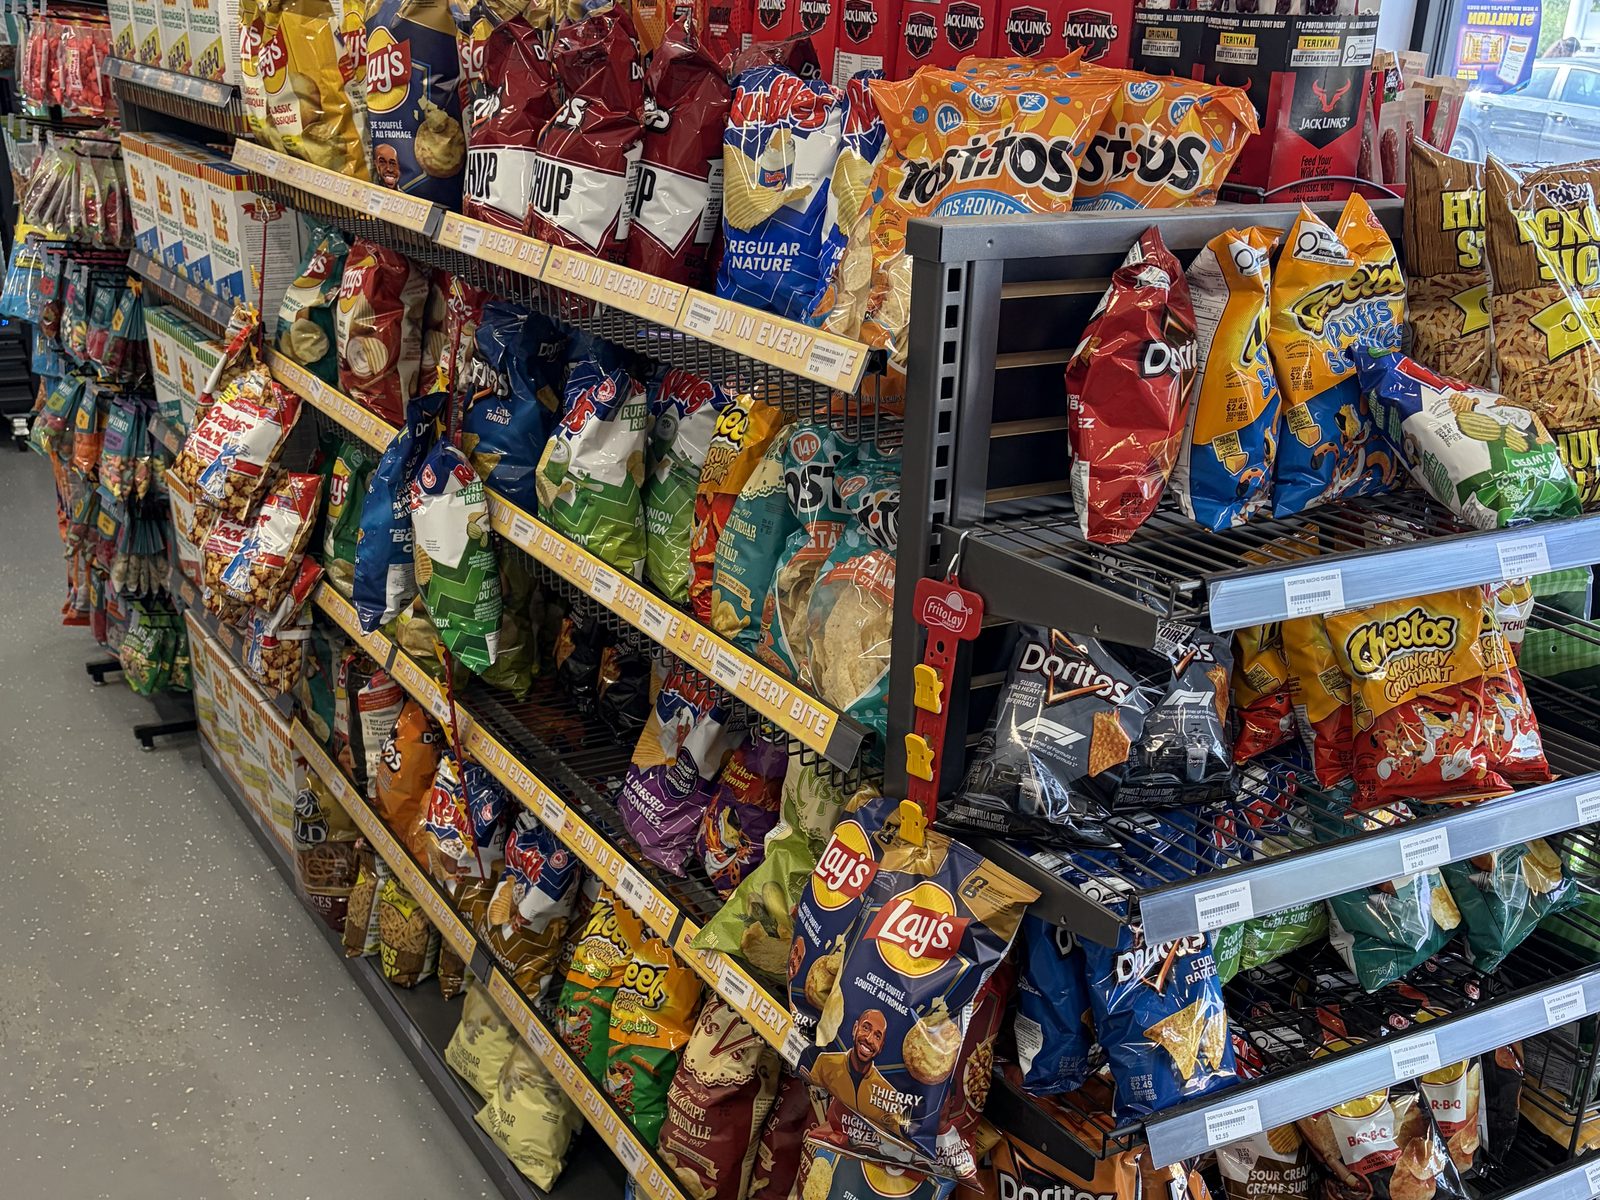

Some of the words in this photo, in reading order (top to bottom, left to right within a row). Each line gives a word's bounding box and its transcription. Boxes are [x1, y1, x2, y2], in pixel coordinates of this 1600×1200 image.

[1005, 18, 1027, 34] JACK
[1062, 21, 1086, 37] JACK
[1223, 35, 1250, 45] TERIYAKI
[1303, 39, 1335, 48] TERIYAKI
[385, 130, 412, 139] FROMAGE
[1300, 118, 1322, 130] JACK
[1301, 155, 1317, 166] Feed
[1318, 155, 1333, 166] Your
[532, 158, 573, 215] HUP
[486, 235, 515, 258] EVERY
[516, 244, 544, 266] BITE
[729, 239, 801, 256] REGULAR
[731, 258, 793, 272] NATURE
[563, 257, 588, 280] FUN
[589, 266, 601, 284] IN
[604, 270, 648, 300] EVERY
[649, 285, 681, 313] BITE
[739, 316, 754, 340] IN
[756, 322, 813, 359] EVERY
[539, 534, 563, 562] BITE
[573, 555, 597, 583] FUN
[335, 602, 347, 616] FUN
[372, 636, 390, 657] BITE
[1350, 609, 1458, 675] Cheetos
[1021, 643, 1131, 704] Doritos
[1386, 650, 1451, 679] CRUNCHY
[404, 665, 417, 684] FUN
[418, 680, 425, 696] IN
[692, 634, 719, 664] FUN
[740, 663, 789, 708] EVERY
[789, 697, 830, 738] BITE
[1385, 666, 1453, 702] CROQUANT
[480, 740, 498, 761] FUN
[498, 754, 507, 772] IN
[508, 763, 537, 796] EVERY
[631, 780, 666, 813] DRESSED
[574, 827, 595, 853] FUN
[596, 846, 608, 867] IN
[815, 833, 870, 891] Lay's
[644, 893, 673, 927] BITE
[1289, 911, 1308, 924] SURE
[432, 900, 456, 929] EVERY
[454, 927, 473, 952] BITE
[878, 899, 954, 958] Lay's
[1191, 955, 1215, 971] COOL
[854, 977, 877, 996] SOUFFLÉ
[877, 991, 886, 1002] AU
[885, 996, 909, 1016] FROMAGE
[867, 972, 885, 988] CHEESE
[884, 984, 906, 1001] SOUFFLÉ
[748, 987, 788, 1035] VERY
[553, 1050, 574, 1082] BITE
[584, 1087, 604, 1119] FUN
[603, 1111, 615, 1134] IN
[870, 1084, 923, 1106] THIERRY
[1131, 1081, 1153, 1089] $2.49
[869, 1095, 908, 1114] HENRY
[688, 1139, 706, 1148] 1987
[1215, 1132, 1229, 1140] $2.55
[649, 1170, 676, 1200] BITE
[1000, 1171, 1116, 1200] Dorito
[1246, 1182, 1286, 1195] CRÈME
[1250, 1170, 1280, 1182] SOUR
